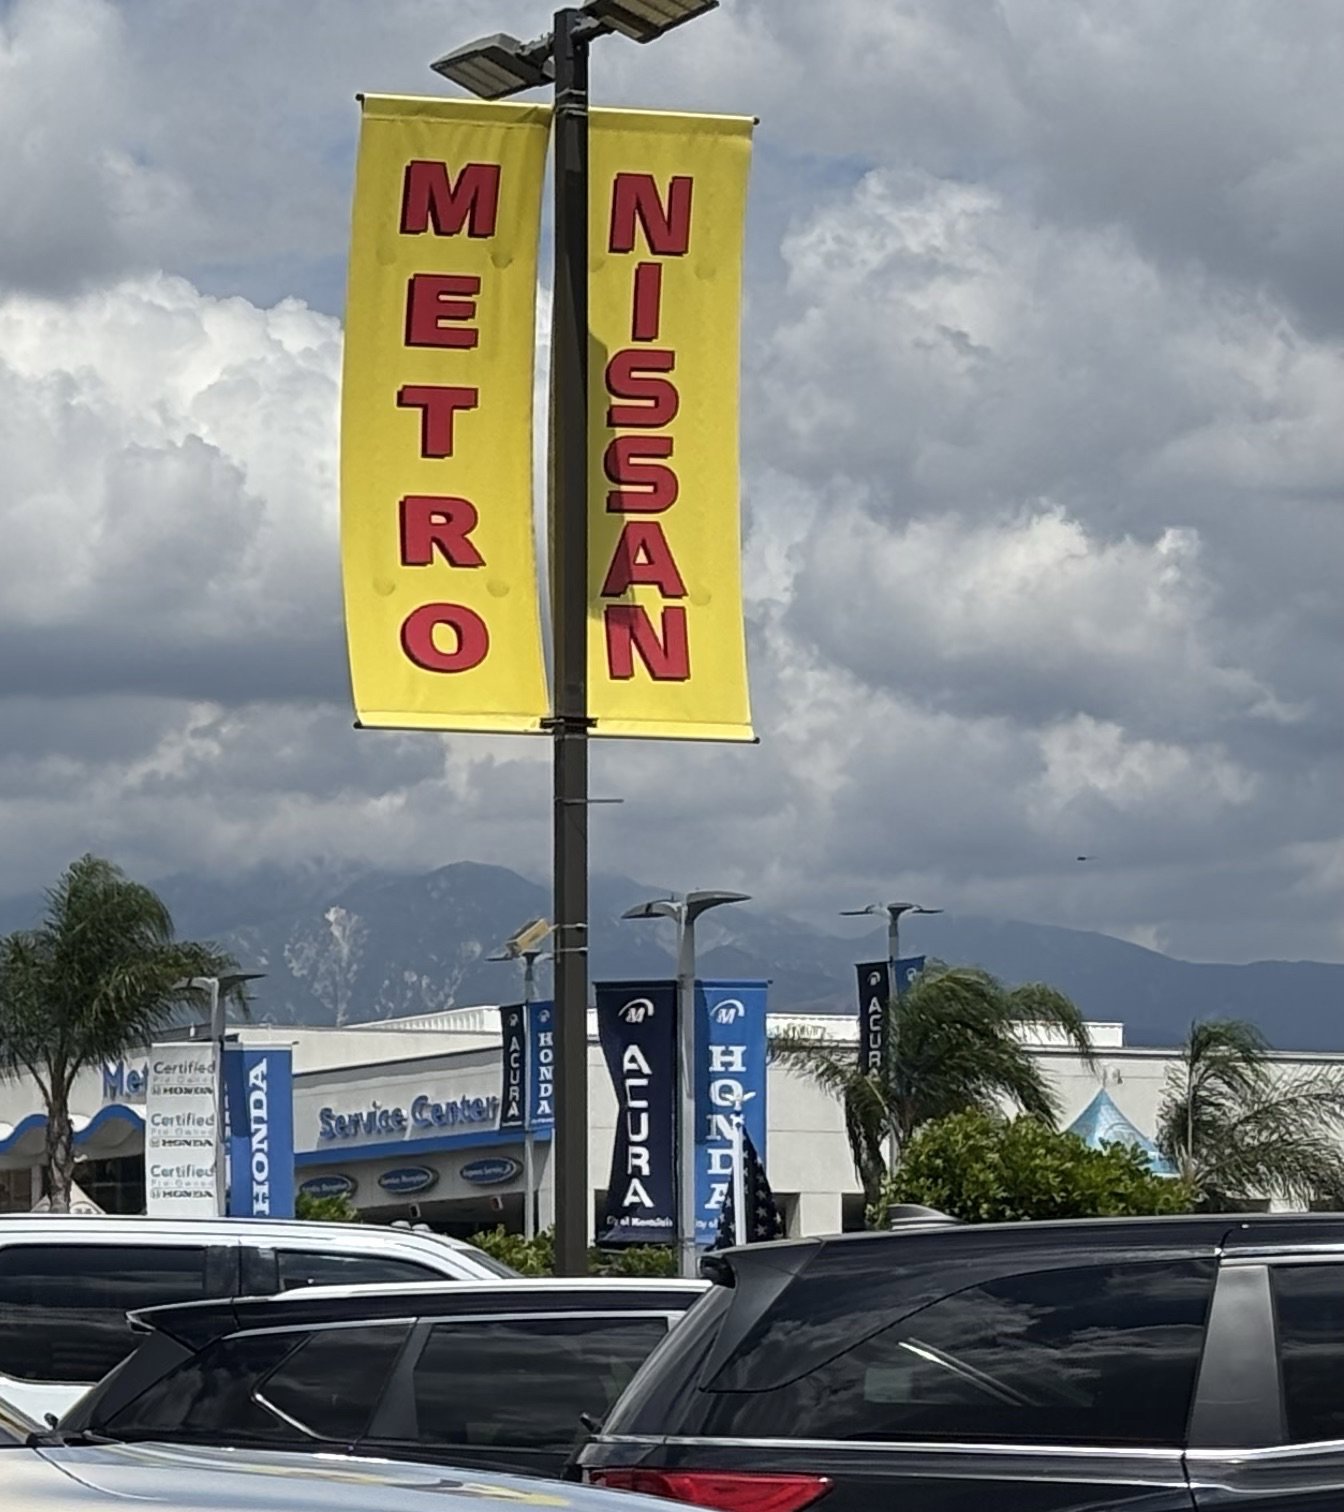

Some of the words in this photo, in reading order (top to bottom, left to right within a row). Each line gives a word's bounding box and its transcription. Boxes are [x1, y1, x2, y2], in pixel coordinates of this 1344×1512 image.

[397, 159, 501, 673] METRO
[600, 172, 694, 682] NISSAN
[153, 1060, 216, 1075] Certified
[162, 1086, 214, 1095] HONDA
[507, 1036, 520, 1117] ACURA
[537, 1032, 554, 1115] HONDA
[151, 1113, 215, 1127] Certified
[249, 1057, 270, 1217] HONDA
[319, 1100, 408, 1140] Service
[411, 1094, 500, 1129] Center
[622, 1044, 654, 1208] ACURA
[162, 1138, 214, 1147] HONDA
[150, 1164, 215, 1178] Certified
[162, 1189, 214, 1198] HONDA
